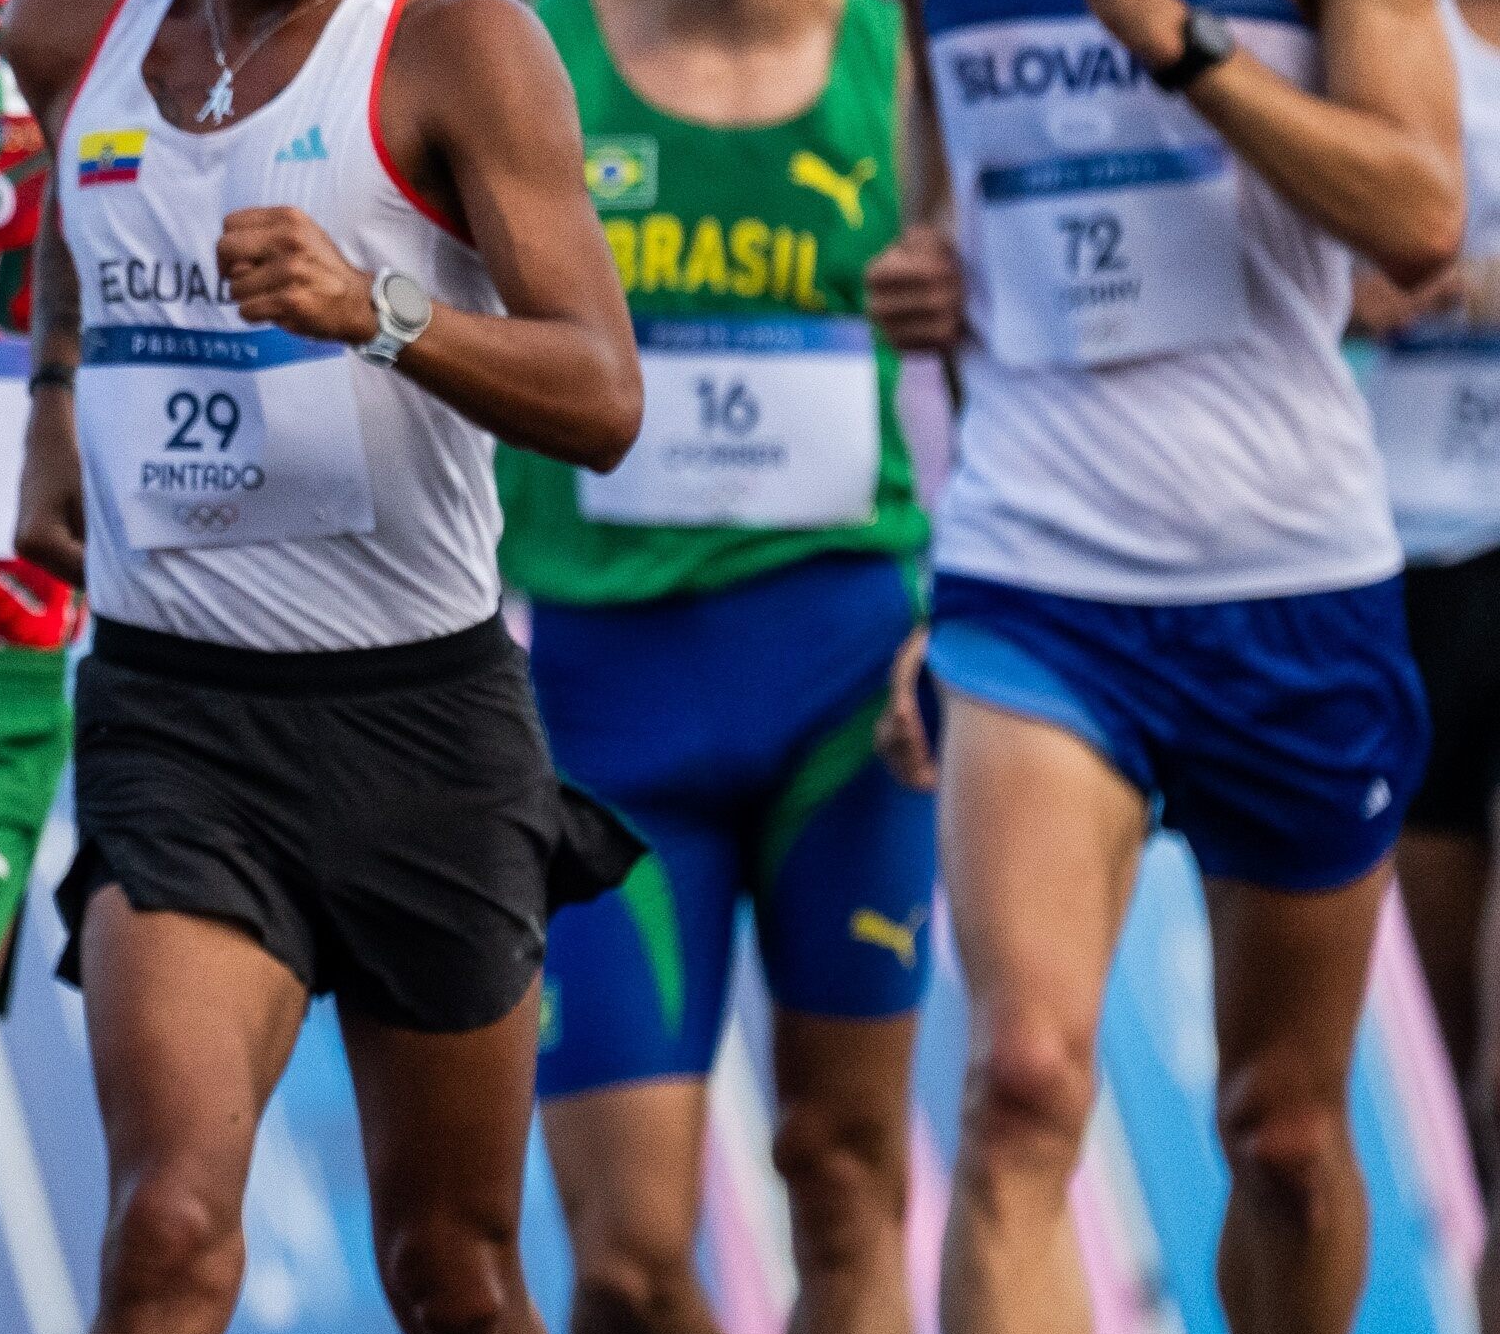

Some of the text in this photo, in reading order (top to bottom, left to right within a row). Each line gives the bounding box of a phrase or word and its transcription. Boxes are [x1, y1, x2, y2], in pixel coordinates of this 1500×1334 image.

[1055, 213, 1128, 273] 72
[163, 391, 242, 454] 29
[694, 373, 762, 436] 16
[141, 462, 267, 491] PINTADO
